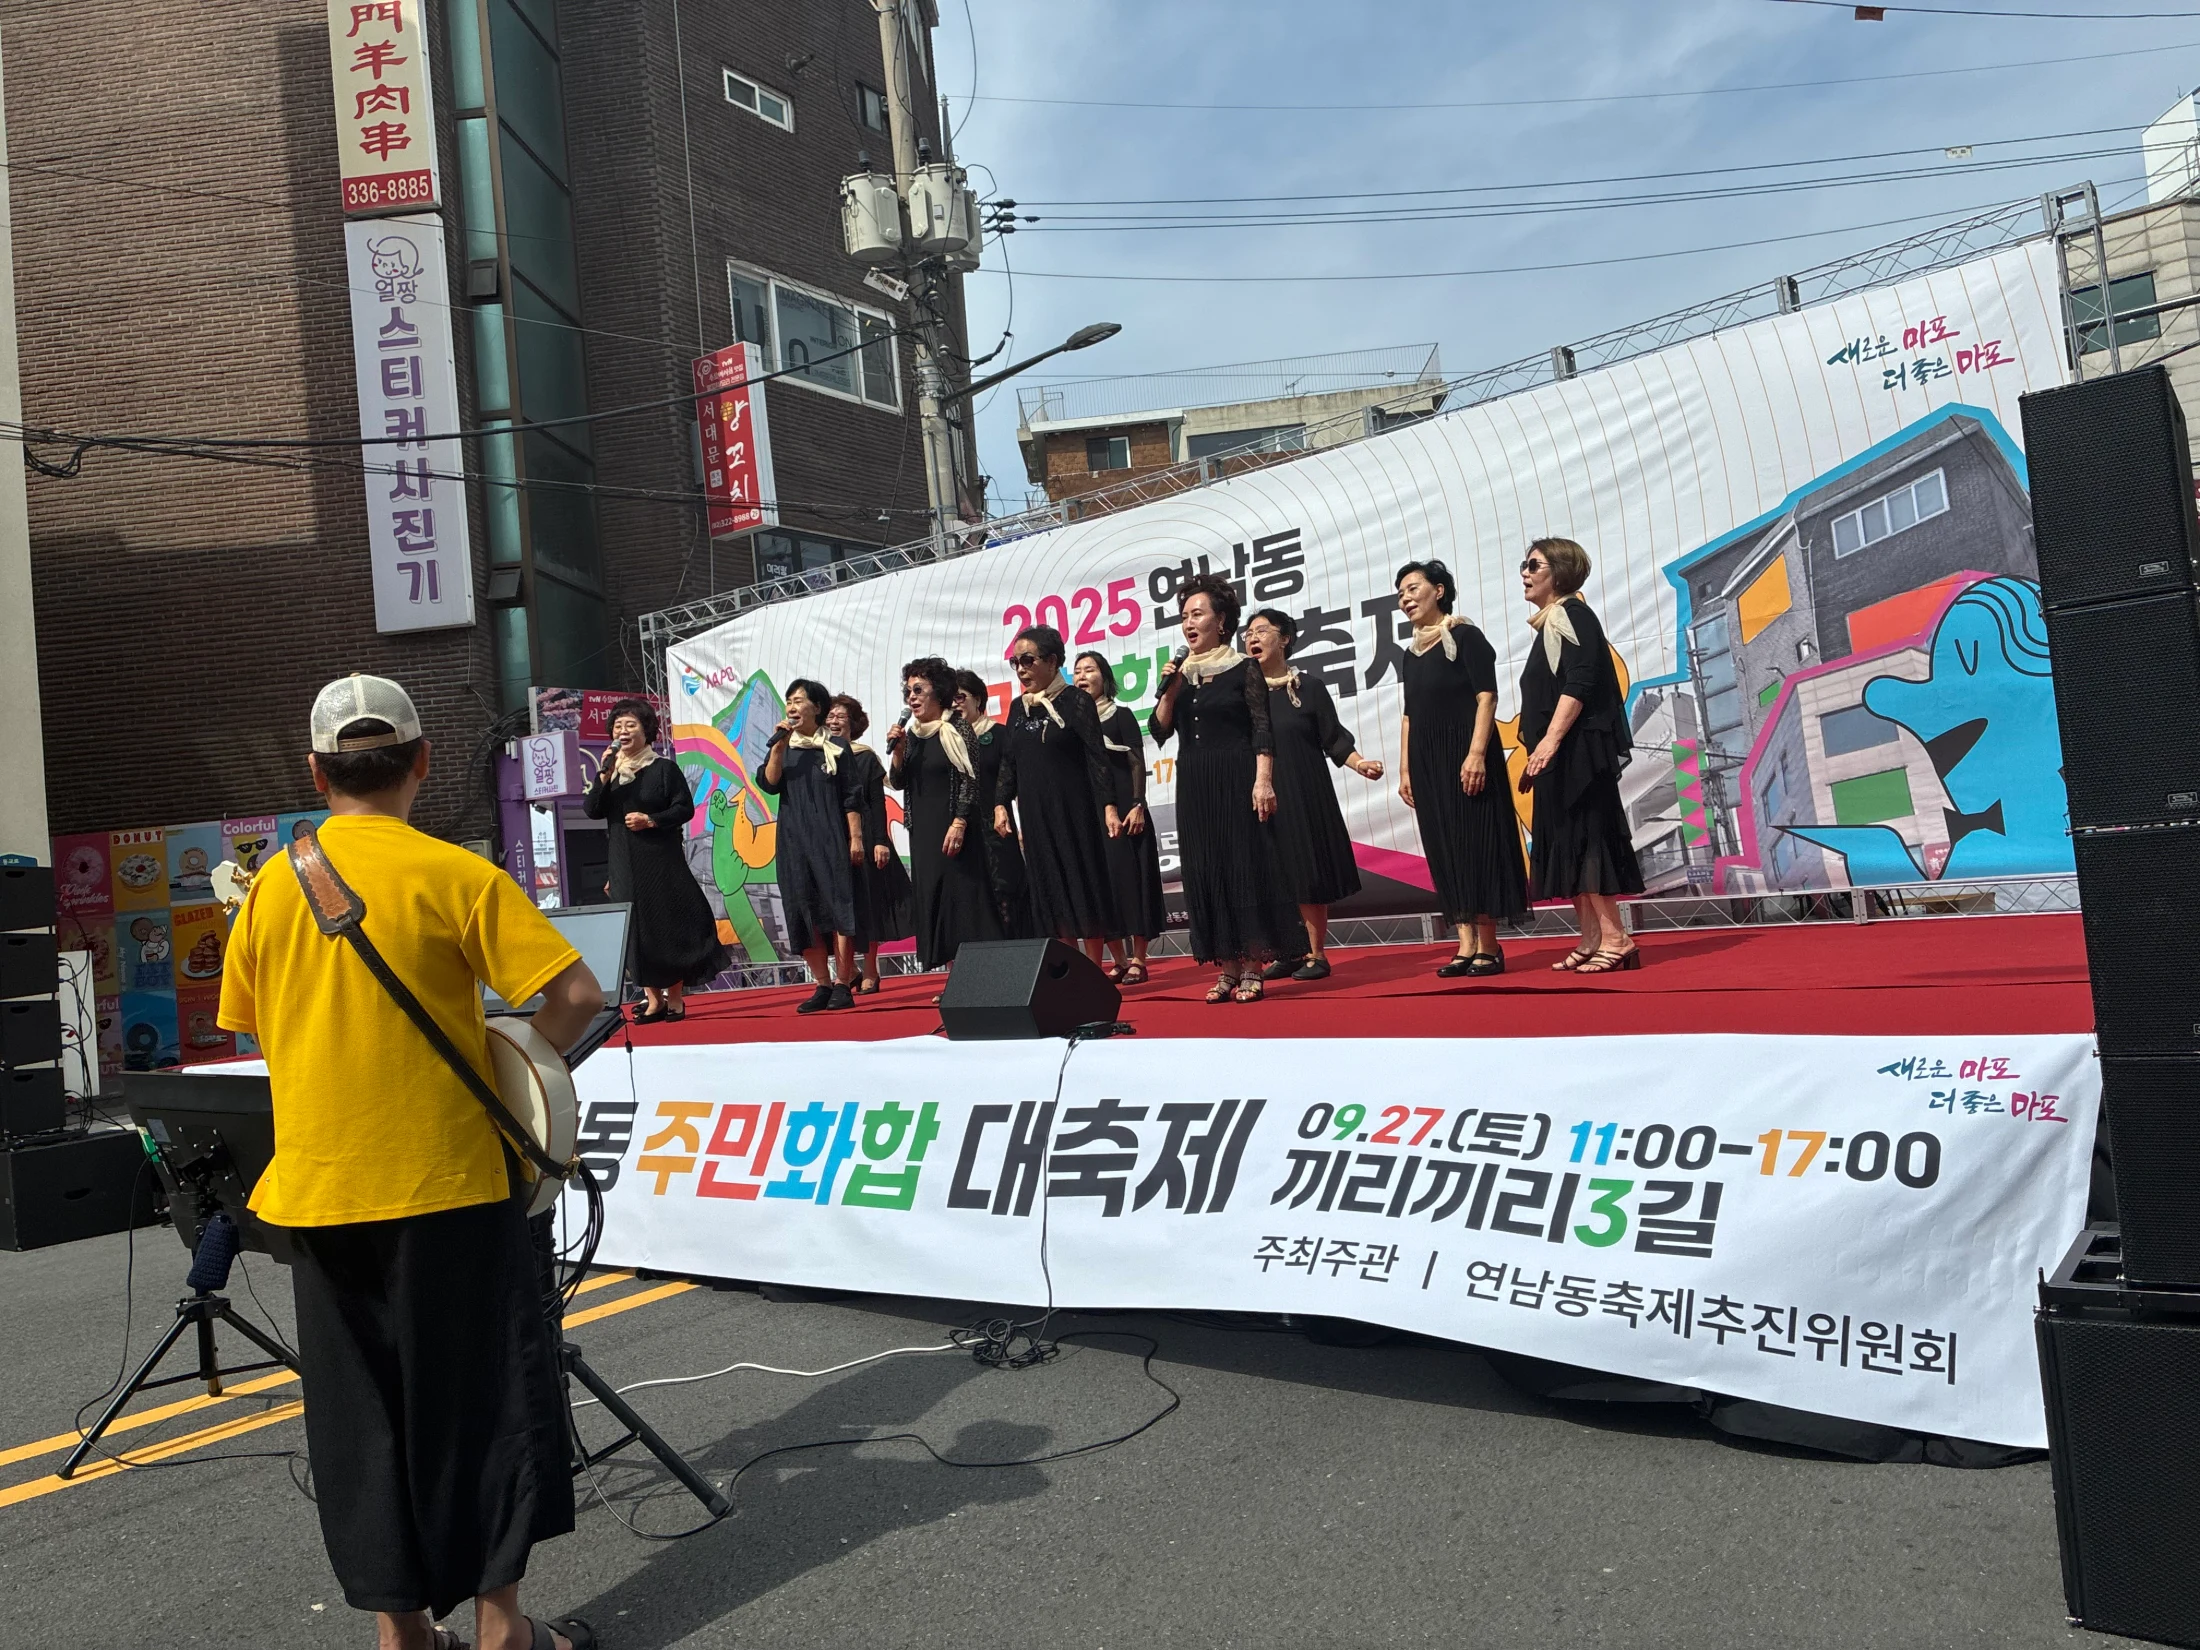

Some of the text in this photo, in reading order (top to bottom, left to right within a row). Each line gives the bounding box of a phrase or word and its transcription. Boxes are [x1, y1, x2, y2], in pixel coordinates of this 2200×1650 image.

[348, 176, 429, 205] 336-8885
[375, 278, 418, 304] 얼짱
[1827, 316, 1960, 366] 새로운 마포
[1883, 339, 2015, 391] 더 좋은 마포
[377, 306, 442, 604] 스티커사진기
[703, 401, 720, 464] 서대문
[720, 399, 749, 503] 양꼬치
[1003, 577, 1141, 661] 2025
[1237, 594, 1413, 699] 축제
[534, 766, 555, 785] 얼짱
[113, 830, 163, 844] DONUT
[223, 818, 276, 835] Colorful
[1876, 1055, 2021, 1082] 새로운 마포
[1929, 1088, 2069, 1123] 더 좋은 마포
[569, 1098, 1268, 1218] 동 주민화합 대축제
[1297, 1102, 1941, 1189] 09.27.(토) 11:00-17:00
[1270, 1149, 1723, 1259] 끼리끼리3길
[1253, 1235, 1957, 1386] 주최주관 연남동축제추진위원회
